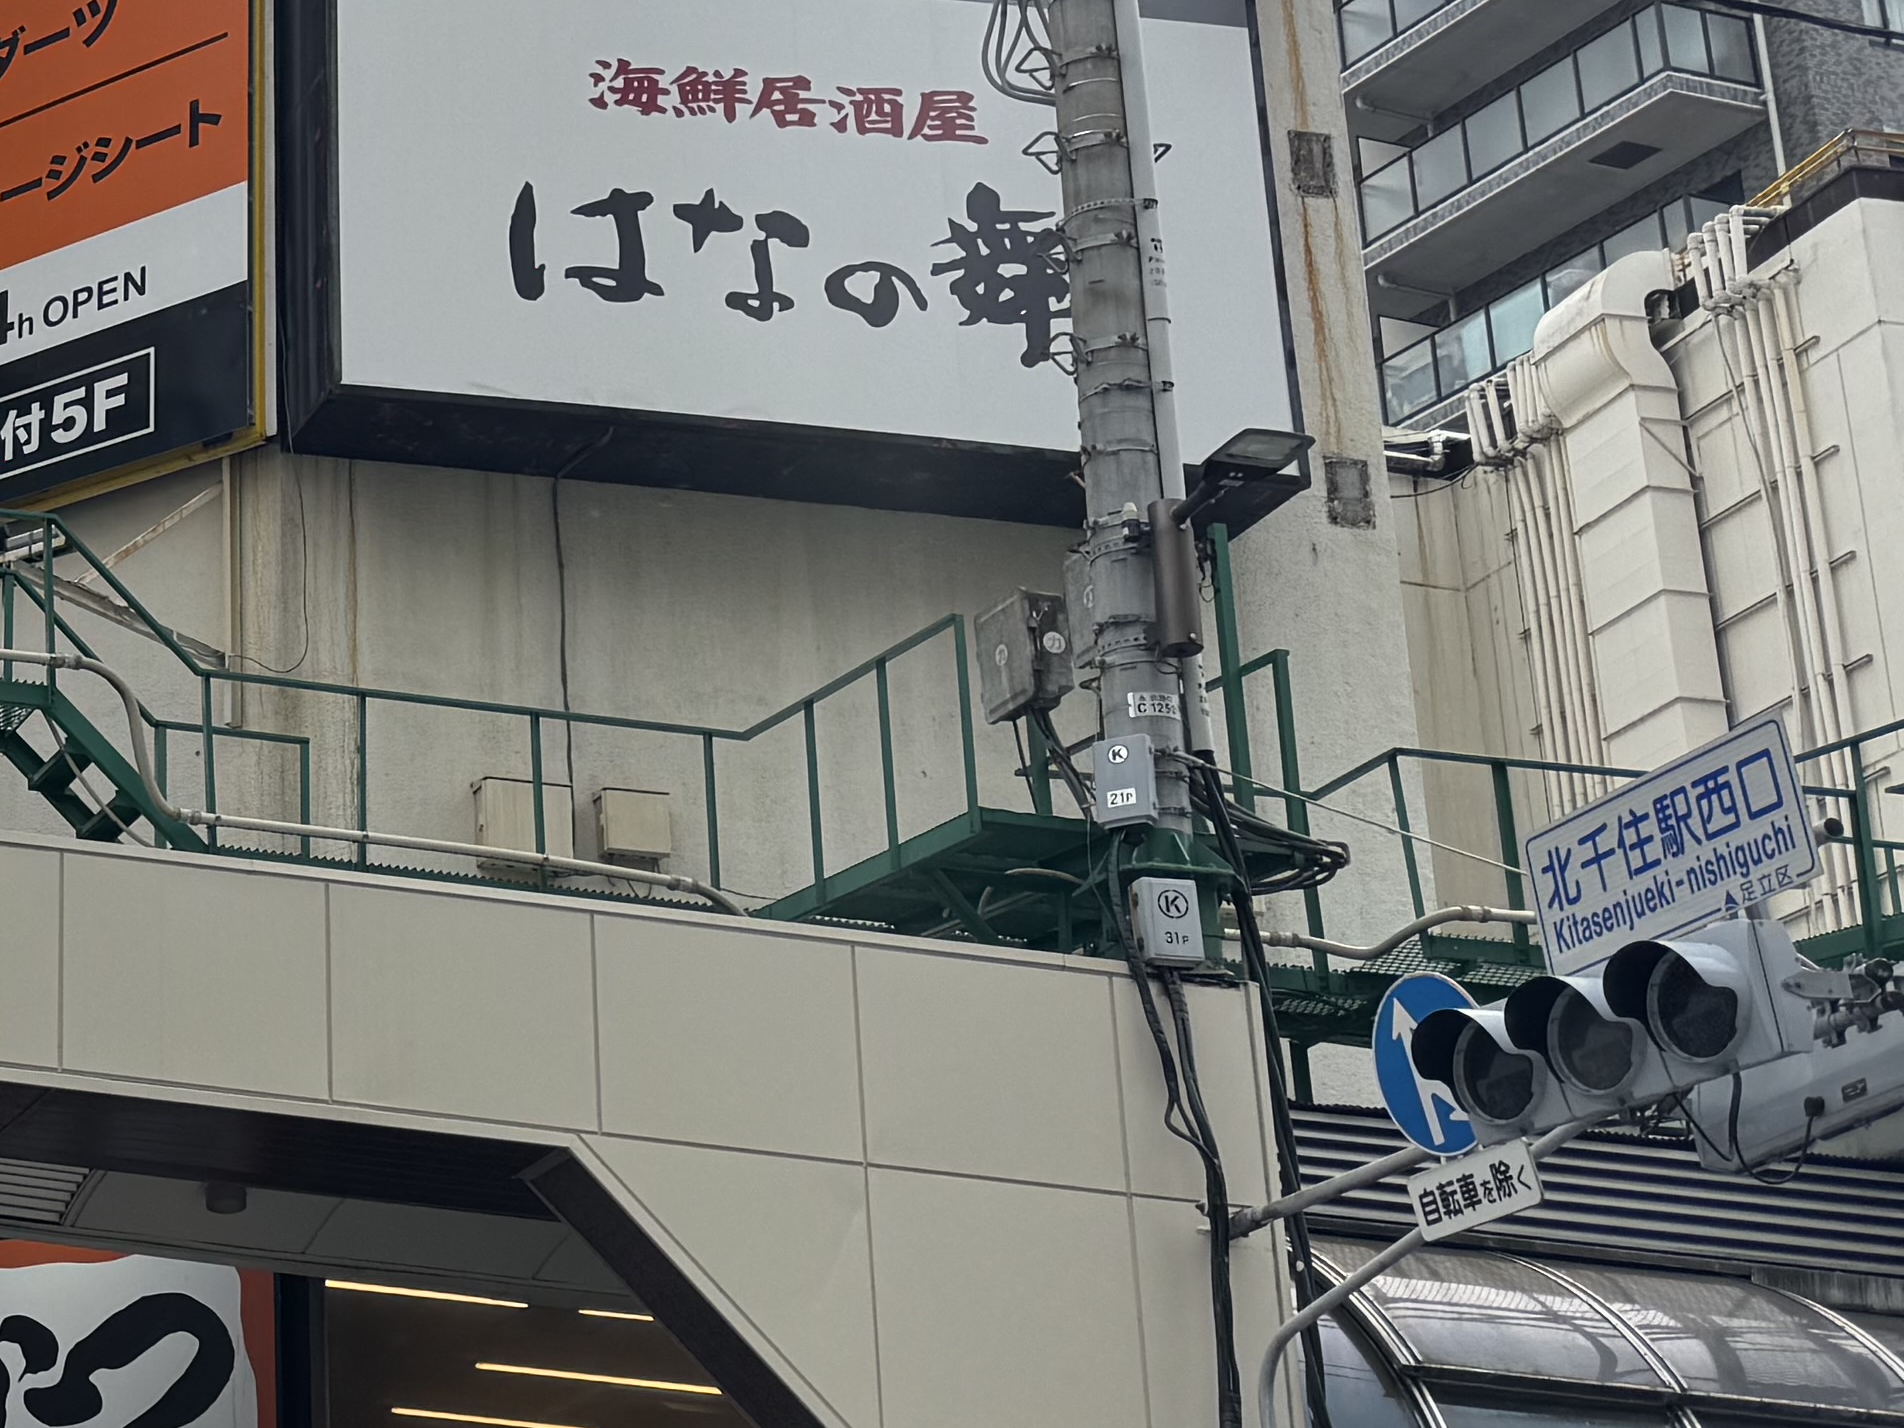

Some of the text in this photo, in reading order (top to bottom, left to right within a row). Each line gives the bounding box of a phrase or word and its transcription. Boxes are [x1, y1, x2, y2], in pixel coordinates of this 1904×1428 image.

[588, 59, 990, 147] 海鮮居酒屋
[42, 266, 148, 329] OPEN
[509, 181, 1072, 369] はなの舞
[1111, 749, 1125, 762] K
[1540, 747, 1786, 913] 北千住駅西口
[1165, 895, 1182, 915] K
[1553, 814, 1798, 955] Kitasenjueki-nishiguchi
[1739, 865, 1794, 906] 足立区
[1417, 1162, 1533, 1228] 自転車を除く
